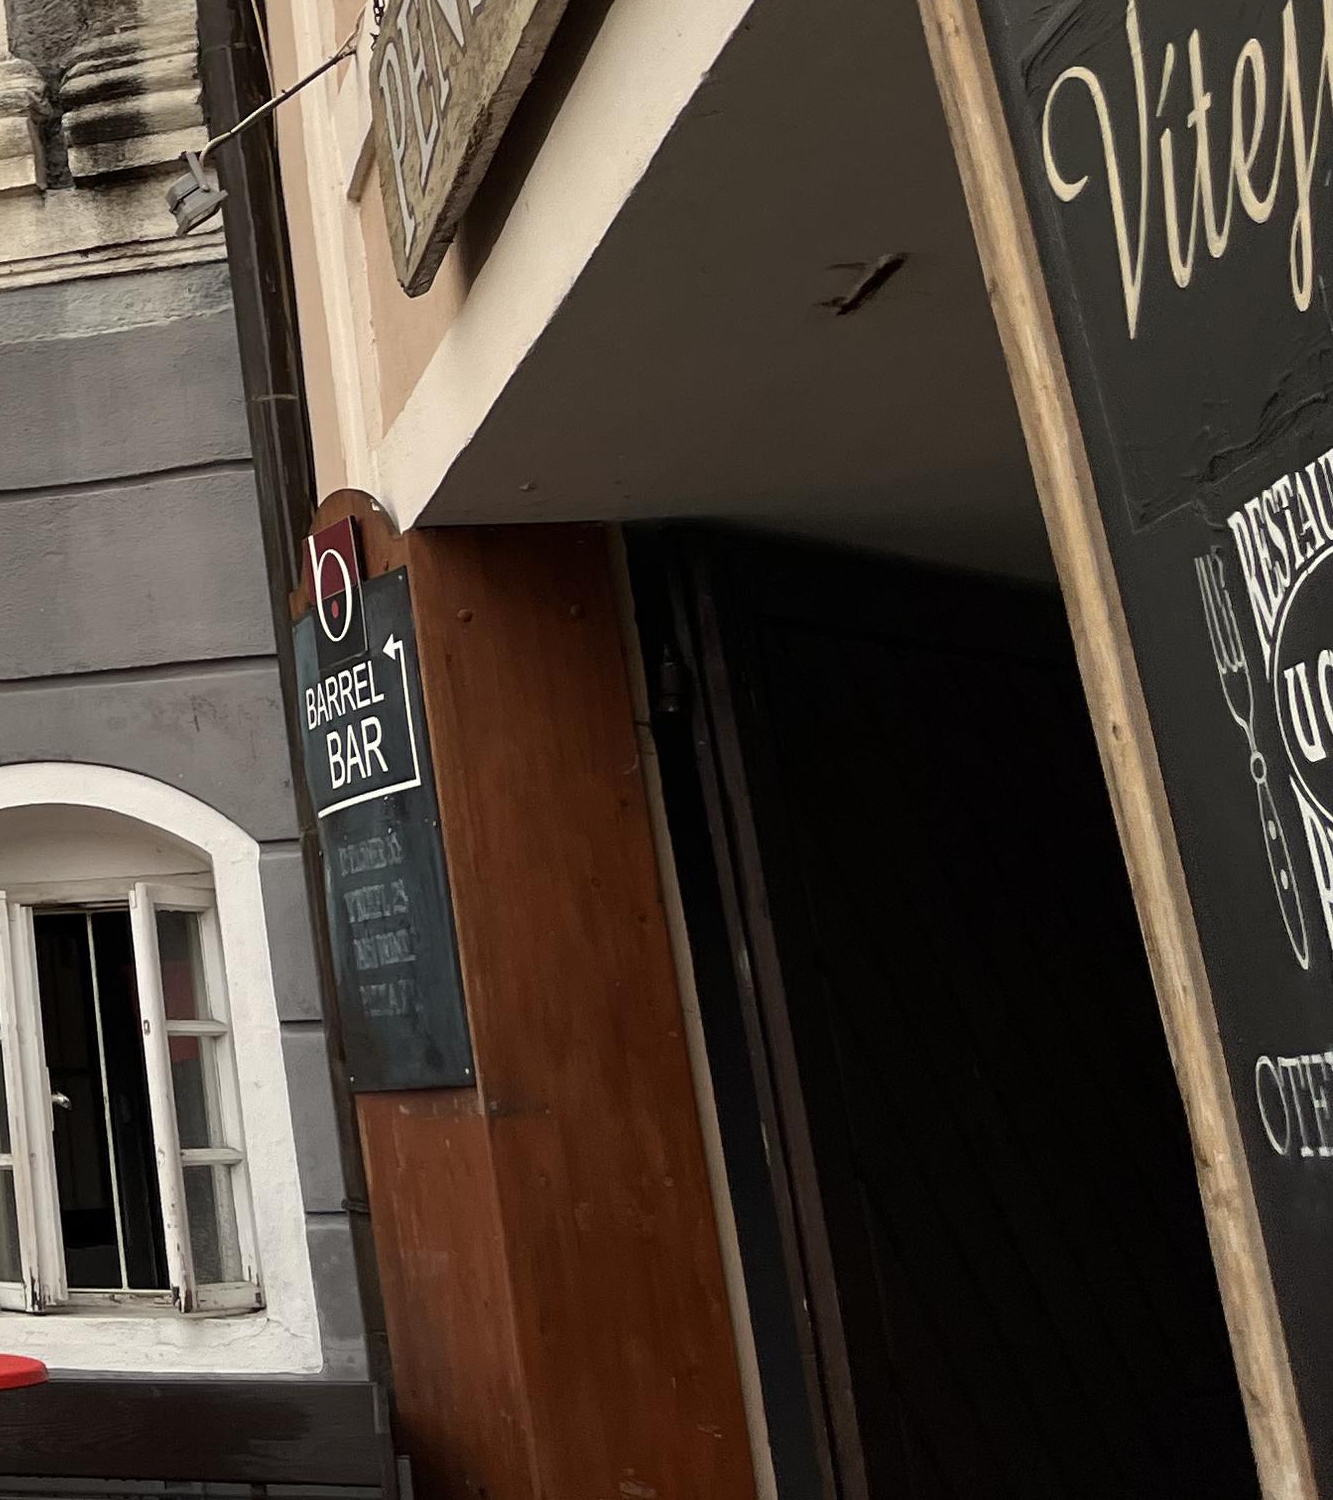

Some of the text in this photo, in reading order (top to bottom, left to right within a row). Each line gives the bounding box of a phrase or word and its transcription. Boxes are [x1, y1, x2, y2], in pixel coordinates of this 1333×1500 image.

[304, 660, 385, 731] BARREL
[1283, 649, 1333, 763] U
[326, 716, 388, 790] BAR
